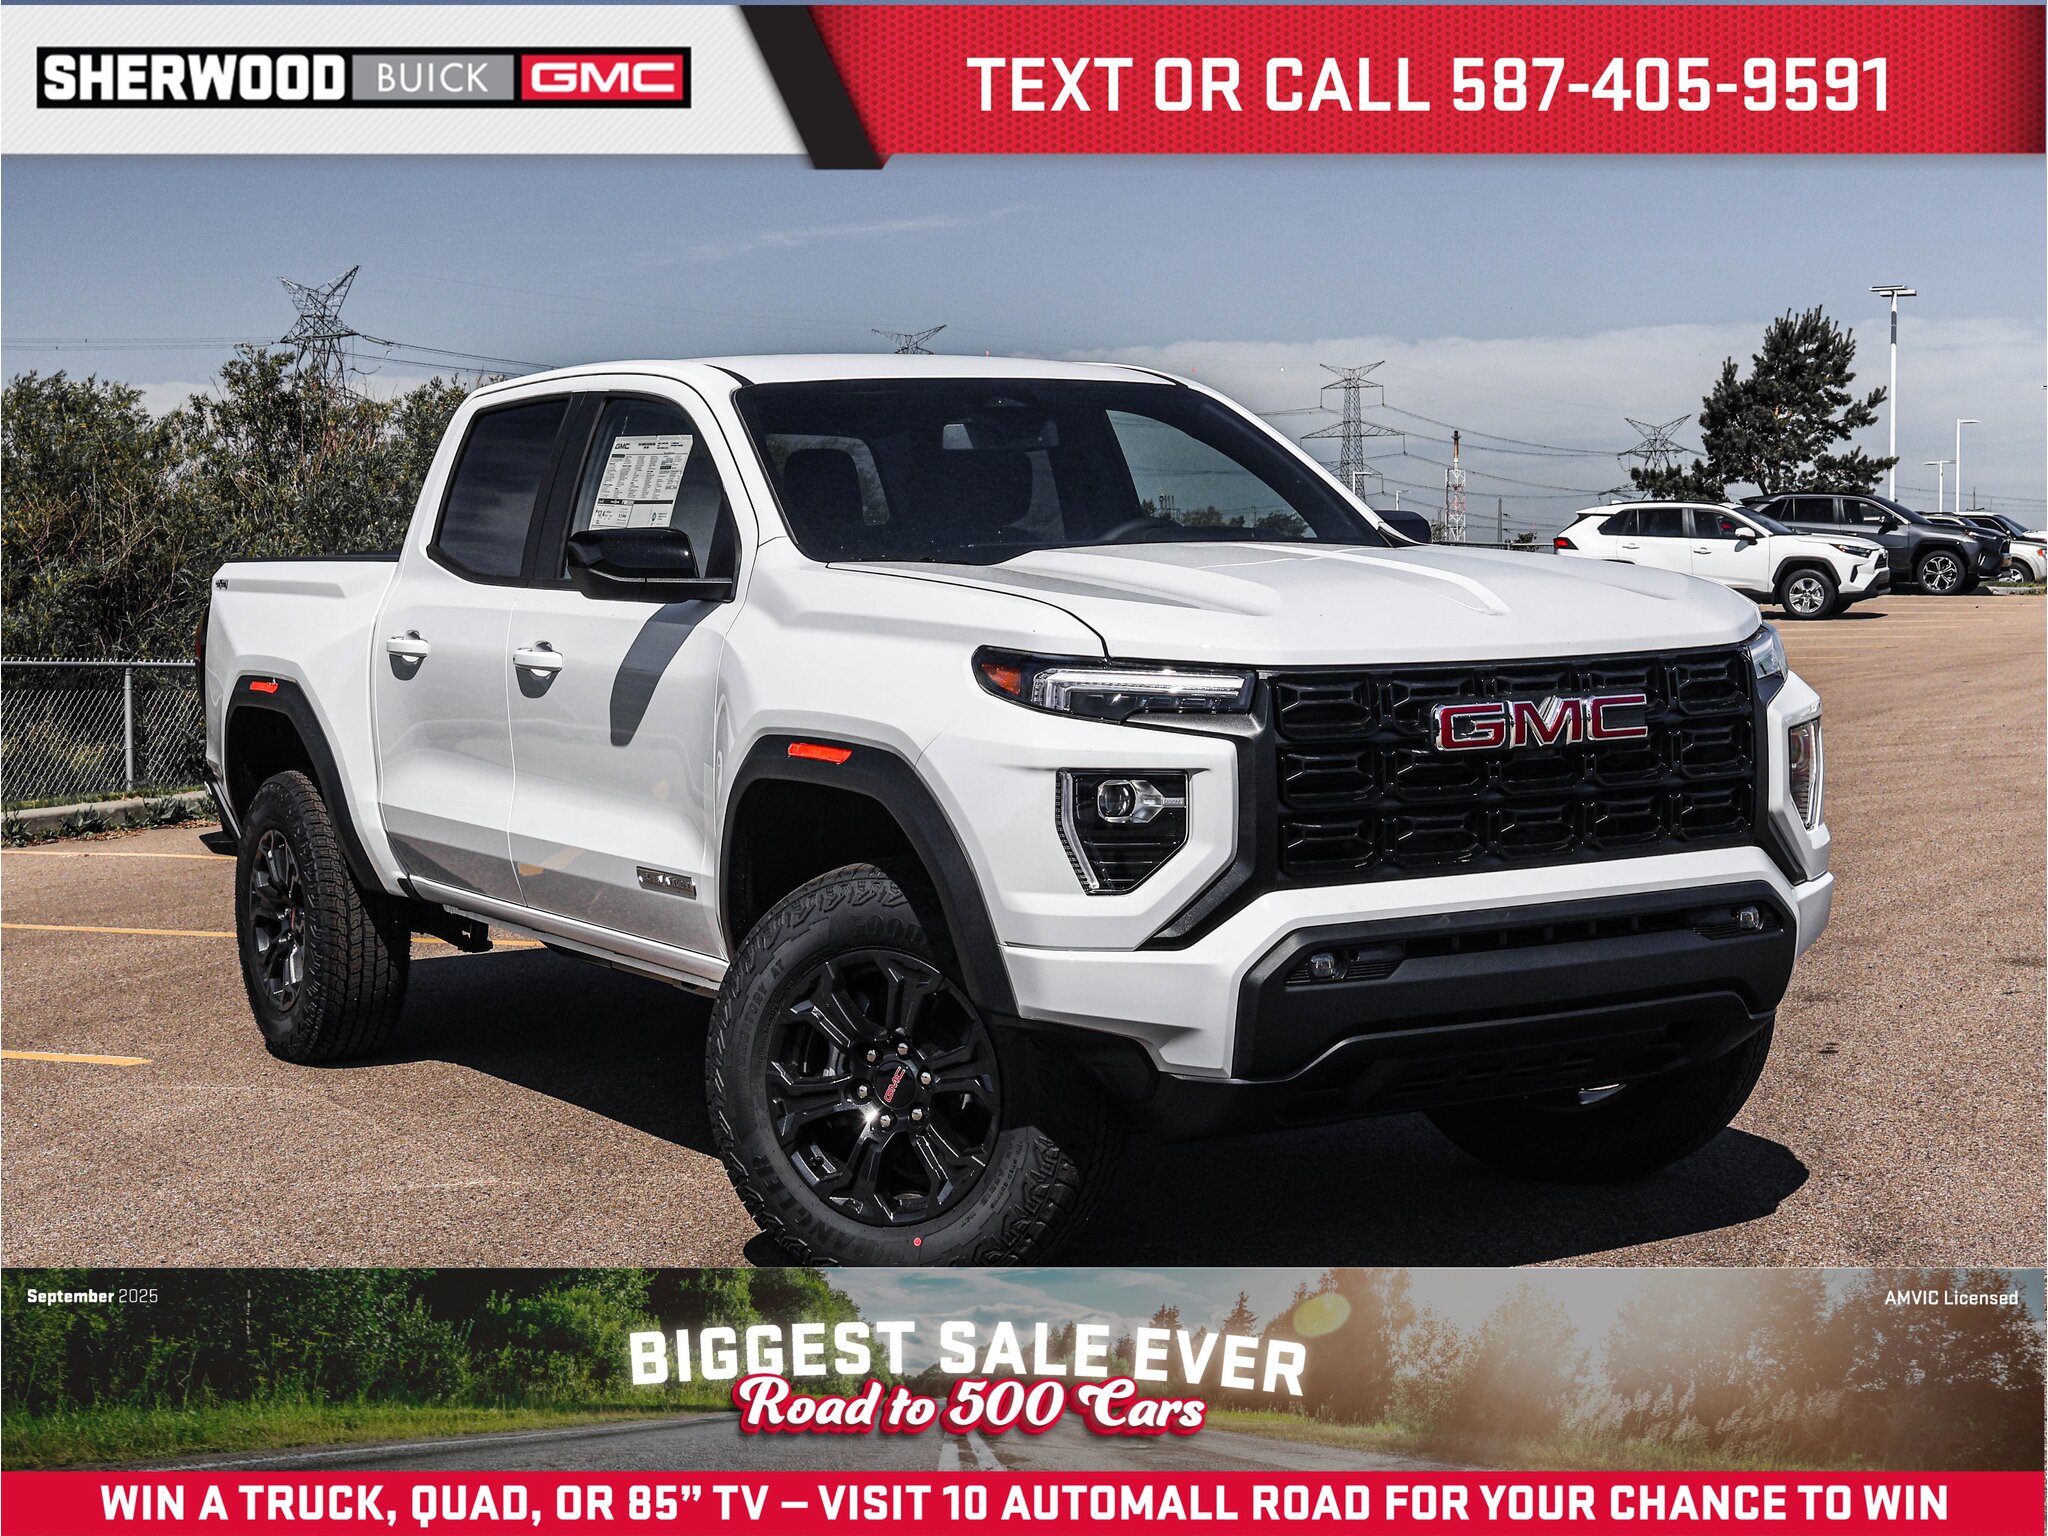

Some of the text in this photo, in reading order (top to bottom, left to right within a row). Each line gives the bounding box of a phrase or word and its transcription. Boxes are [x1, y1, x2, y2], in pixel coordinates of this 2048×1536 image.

[1434, 694, 1648, 751] GMC
[770, 958, 785, 980] AT
[884, 1066, 906, 1103] GMC
